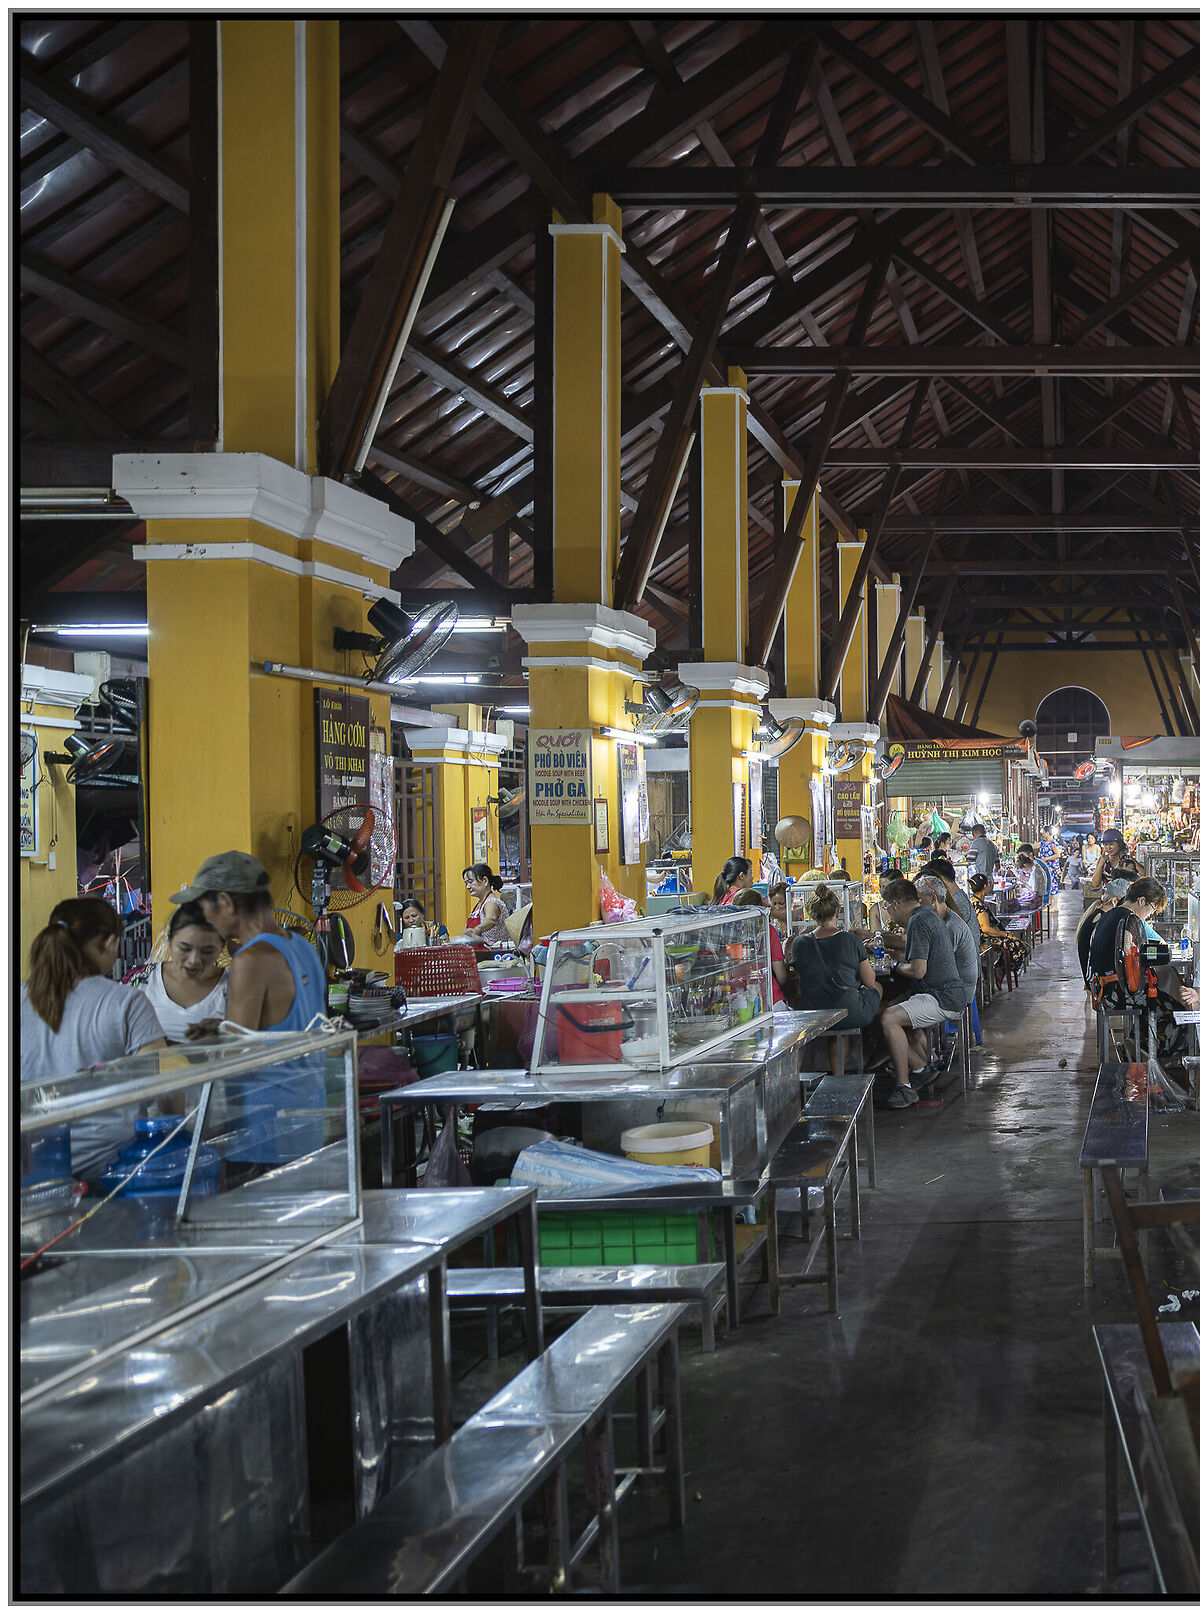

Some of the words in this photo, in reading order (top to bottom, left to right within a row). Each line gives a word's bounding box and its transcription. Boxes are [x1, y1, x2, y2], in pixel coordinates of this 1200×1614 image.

[322, 713, 346, 746] HÀNG
[347, 721, 366, 748] CƠM
[534, 748, 552, 768] PHỞ
[553, 750, 565, 768] BÒ
[566, 750, 587, 768] VIÊN
[907, 748, 940, 759] HUỲNH
[942, 750, 959, 759] THỊ
[961, 749, 979, 757] KIM
[982, 748, 1002, 758] HỌC
[535, 778, 564, 797] PHỞ
[567, 779, 587, 797] GÀ
[837, 792, 849, 800] CAO
